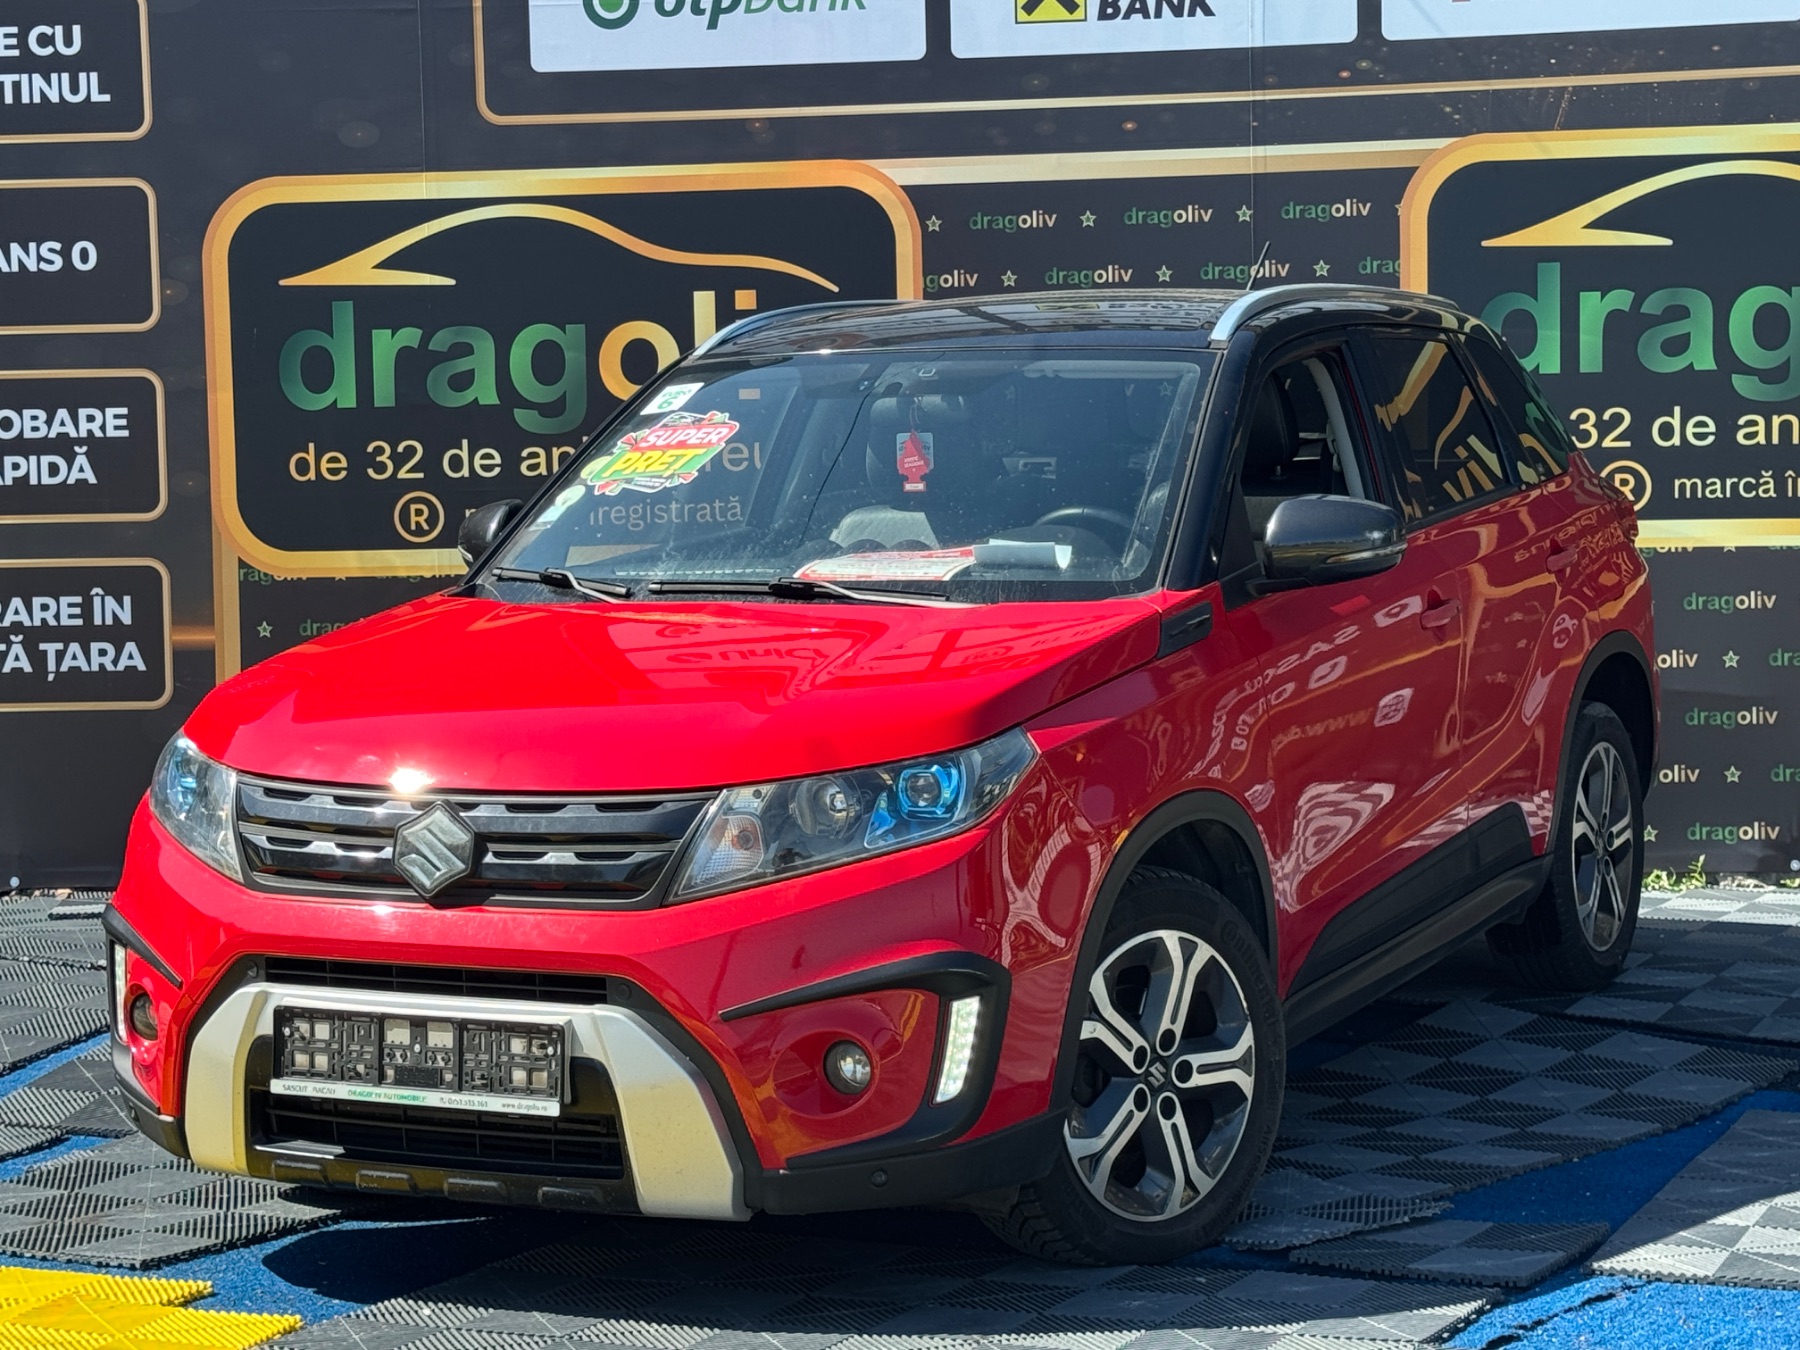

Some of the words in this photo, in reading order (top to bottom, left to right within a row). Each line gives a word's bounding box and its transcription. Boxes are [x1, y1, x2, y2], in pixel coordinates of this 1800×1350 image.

[28, 25, 82, 57] CU
[0, 72, 111, 104] TINUL
[970, 211, 1057, 233] dragoliv
[1123, 205, 1213, 228] dragoliv
[1280, 199, 1372, 222] dragoliv
[922, 270, 978, 293] goliv
[1045, 265, 1133, 288] dragoliv
[1200, 260, 1290, 284] dragoliv
[1481, 262, 1800, 402] drag
[0, 407, 130, 440] OBARE
[1569, 407, 1632, 449] 32
[1652, 406, 1717, 447] de
[1736, 413, 1800, 446] an
[638, 427, 731, 448] SUPER
[0, 446, 98, 486] PIDĂ
[290, 443, 348, 482] de
[366, 440, 425, 480] 32
[443, 439, 502, 478] de
[1674, 470, 1777, 500] marcă
[0, 596, 84, 628] ARE
[90, 587, 133, 627] ÎN
[1683, 591, 1777, 615] dragoliv
[0, 634, 34, 674] Ă
[39, 641, 147, 682] ȚARA
[1685, 706, 1778, 730] dragoliv
[1687, 821, 1780, 845] dragoliv
